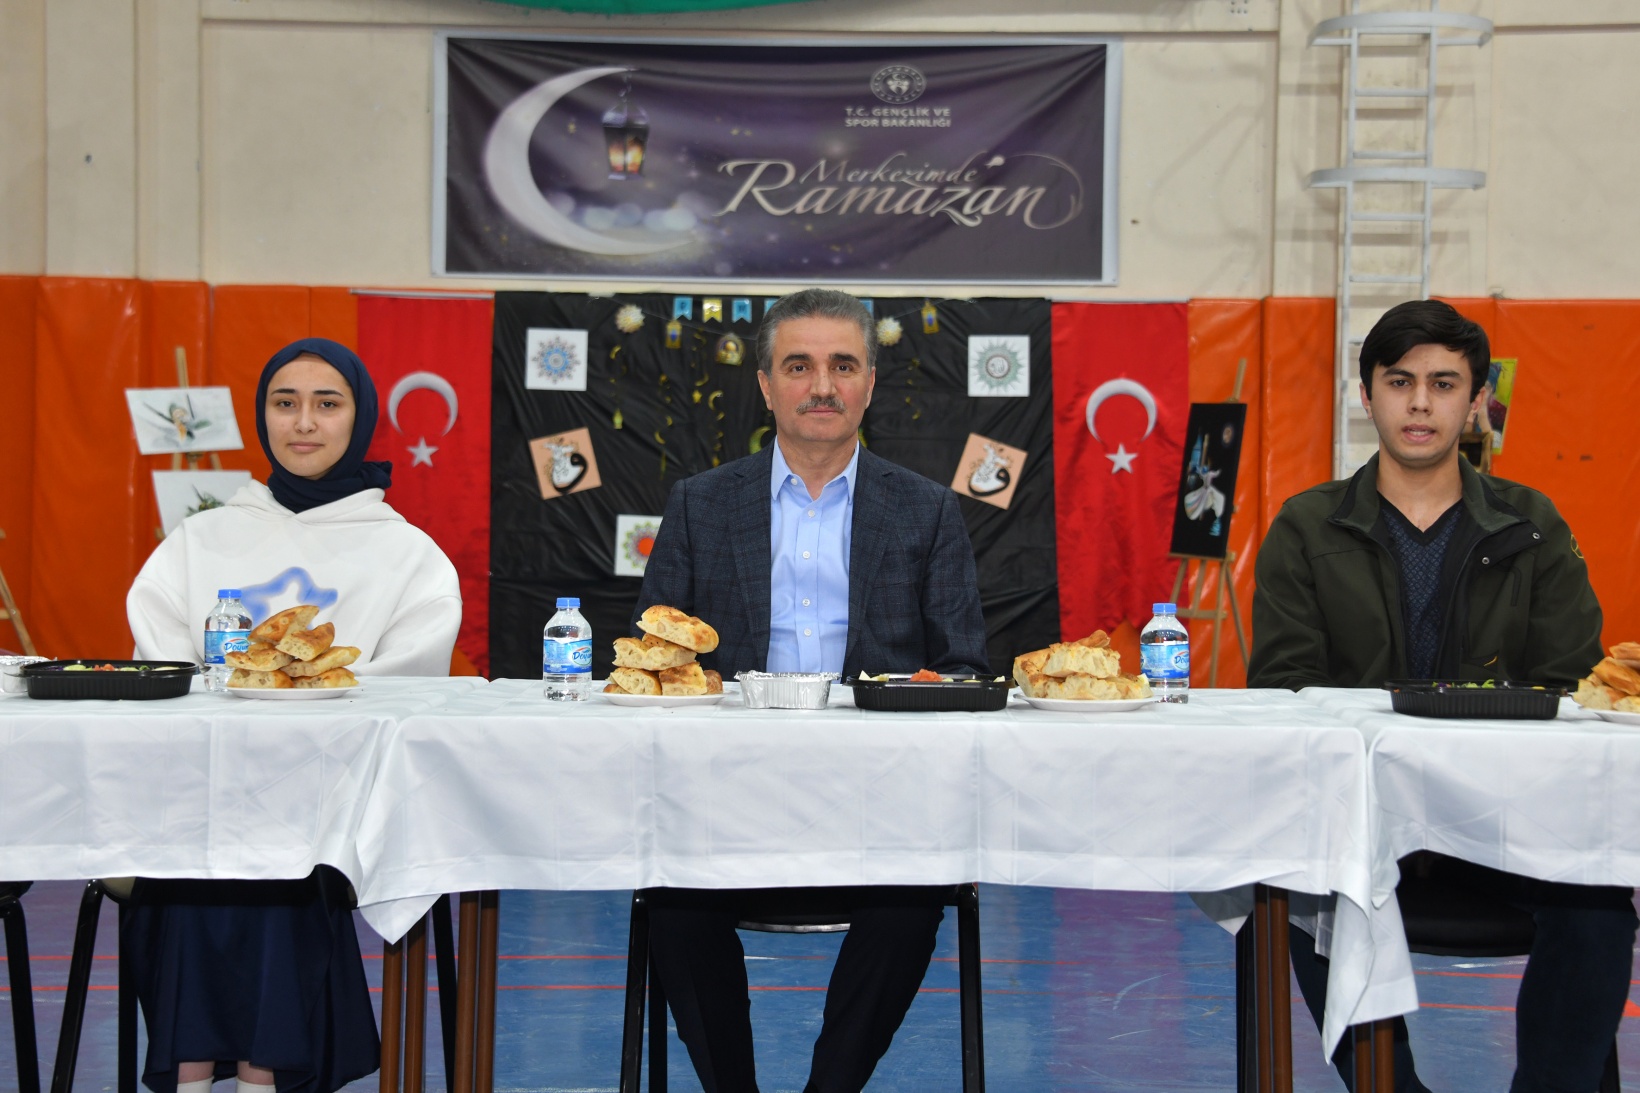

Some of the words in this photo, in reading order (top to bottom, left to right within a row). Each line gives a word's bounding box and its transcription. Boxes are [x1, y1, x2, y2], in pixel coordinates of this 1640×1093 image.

[845, 107, 869, 117] T.C.
[872, 107, 930, 119] GENÇLİK
[933, 107, 951, 117] VE
[845, 118, 879, 128] SPOR
[881, 118, 952, 128] BAKANLIĞI
[800, 150, 988, 187] Merkezimde
[712, 155, 1083, 230] Ramazan
